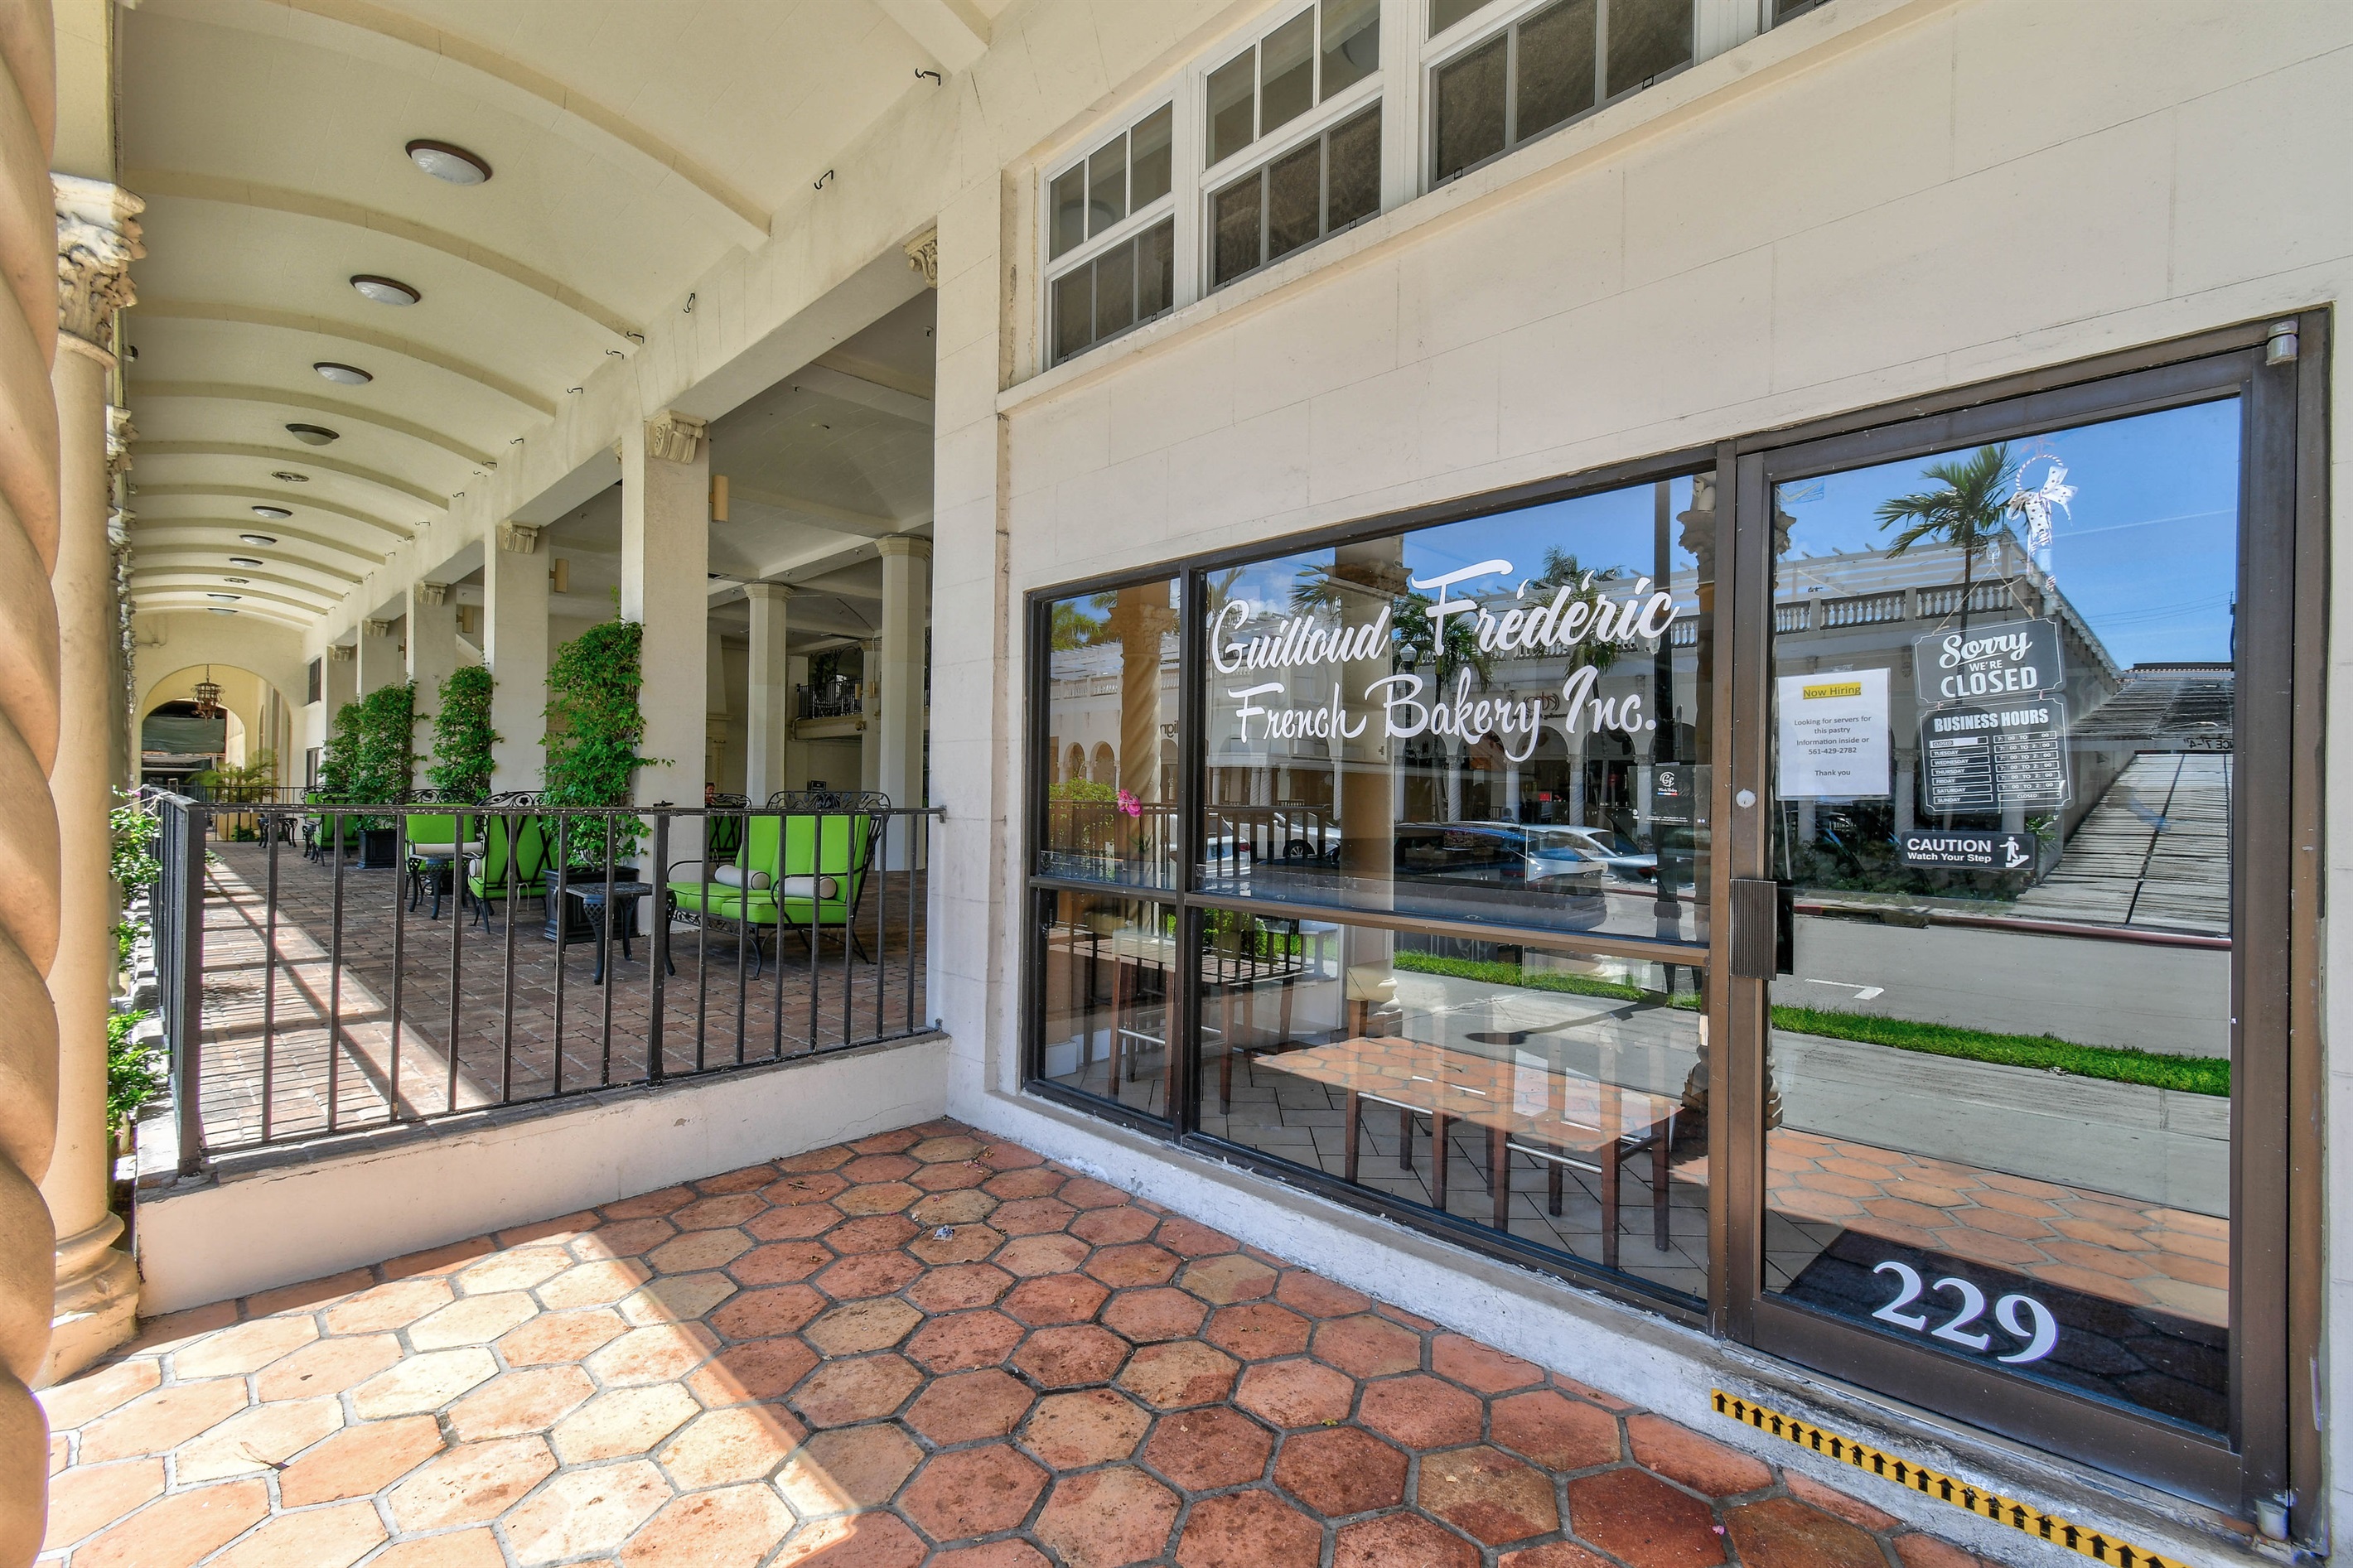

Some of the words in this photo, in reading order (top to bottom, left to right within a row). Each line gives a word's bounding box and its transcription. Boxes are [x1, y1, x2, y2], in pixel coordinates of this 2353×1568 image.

[1211, 599, 1392, 674] Guilloud
[1939, 631, 2032, 668] Sorry
[1969, 659, 2003, 672] WE'RE
[1803, 688, 1827, 698] Now
[1830, 686, 1861, 697] Hiring
[1940, 667, 2038, 697] CLOSED
[1227, 682, 1369, 743] French
[1365, 667, 1542, 762] Bakery
[1562, 664, 1658, 734] Inc.
[1934, 712, 1998, 732] BUSINESS
[2001, 708, 2049, 727] HOURS
[1906, 838, 1992, 852] CAUTION
[1907, 852, 1938, 861] Watch
[1941, 853, 1964, 861] Your
[1966, 854, 1992, 863] Step
[1872, 1260, 2060, 1363] 229
